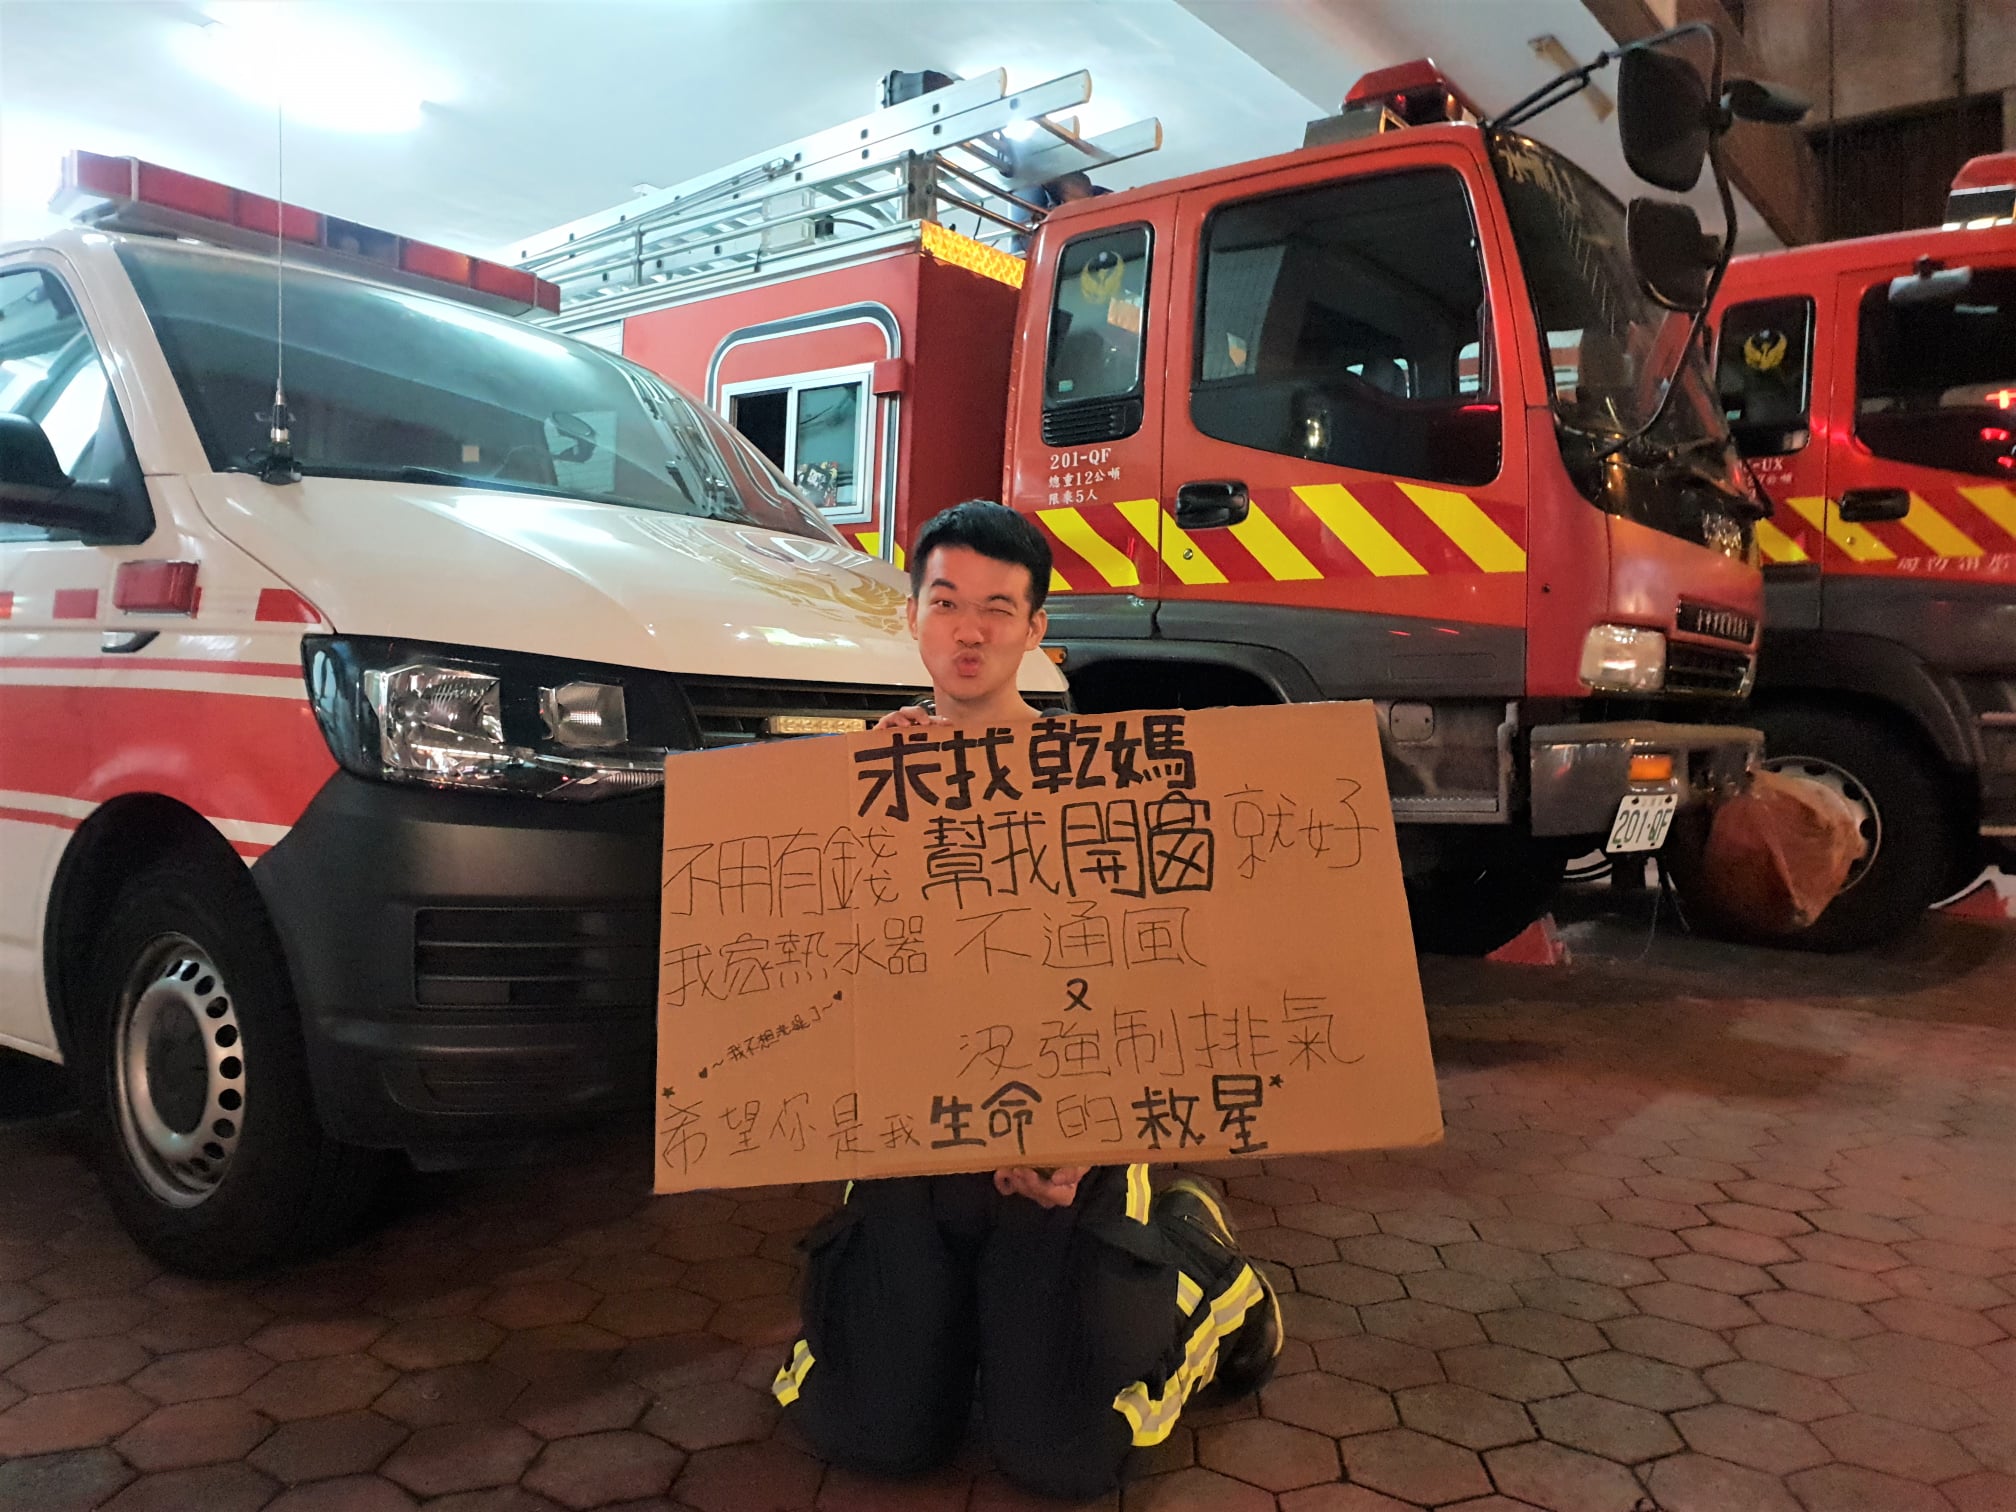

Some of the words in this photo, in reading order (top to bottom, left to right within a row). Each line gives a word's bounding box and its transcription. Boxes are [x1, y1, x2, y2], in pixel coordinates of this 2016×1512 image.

[1049, 447, 1112, 470] 201-QF
[854, 714, 1197, 821] 求找乾媽
[1064, 978, 1092, 1011] 又
